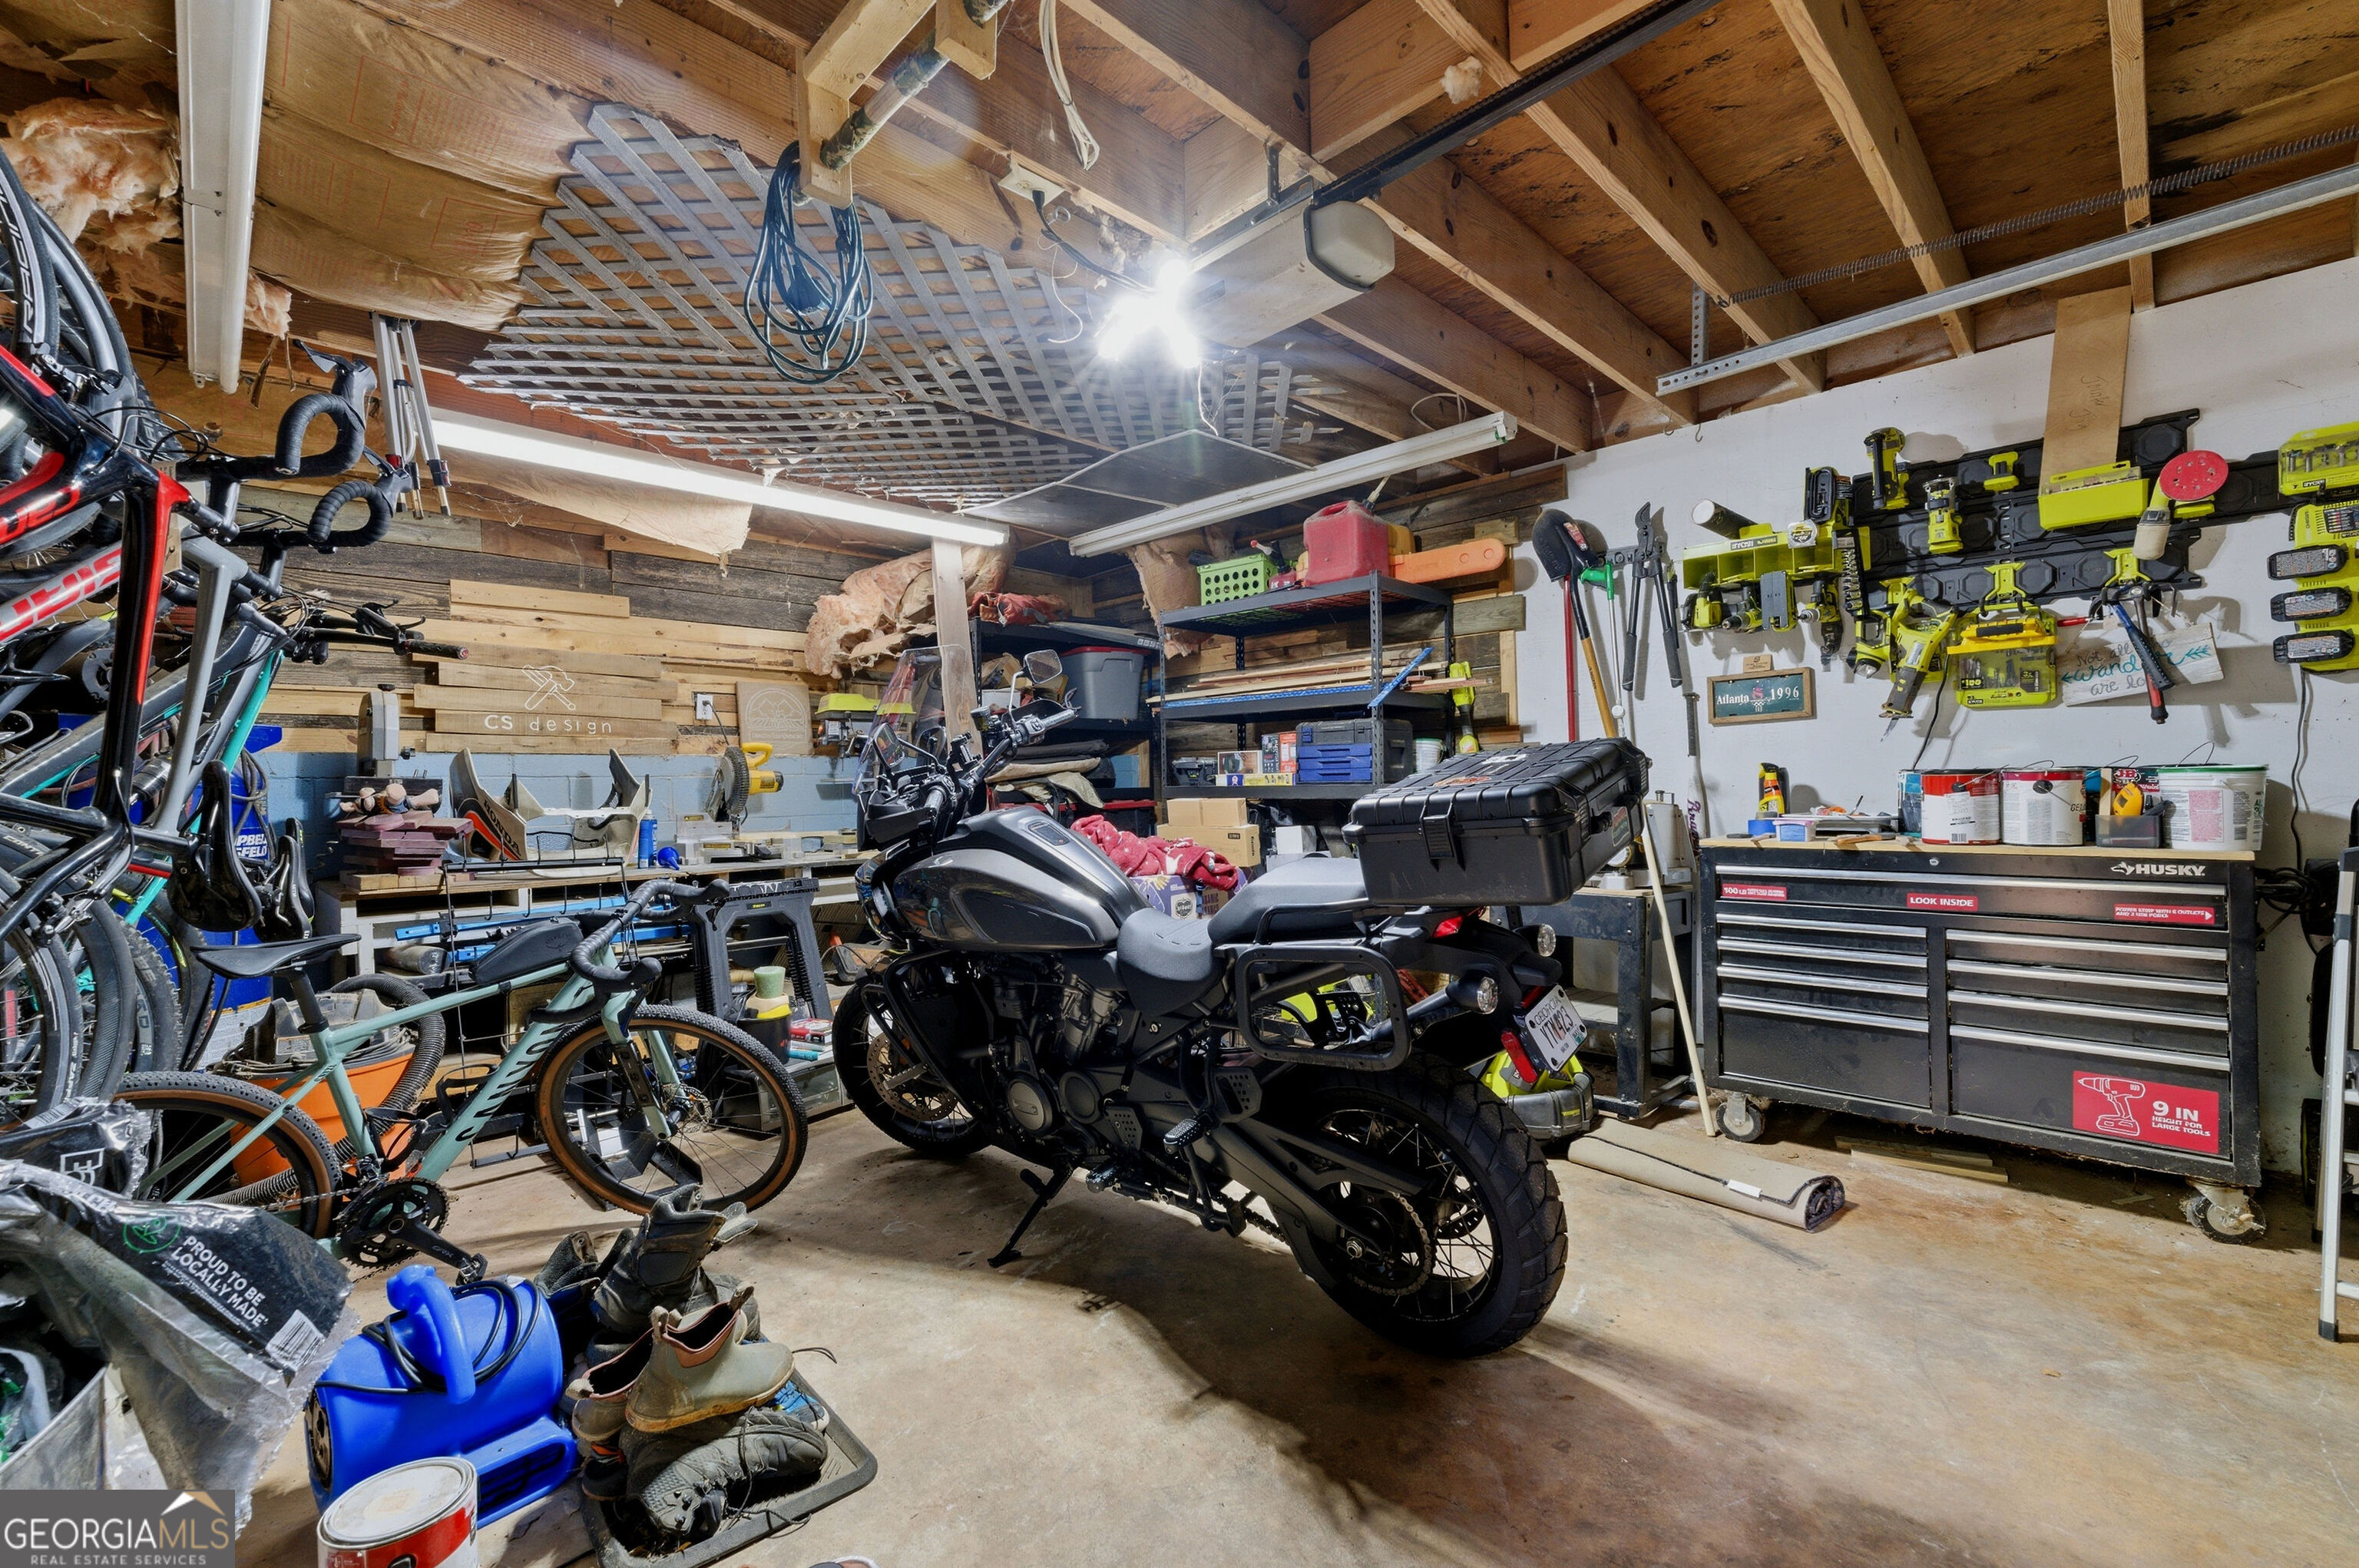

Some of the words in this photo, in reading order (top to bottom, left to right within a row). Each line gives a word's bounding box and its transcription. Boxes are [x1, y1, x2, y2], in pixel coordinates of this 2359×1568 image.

[2076, 650, 2103, 667] Not
[2109, 643, 2132, 659] all
[1716, 693, 1750, 706] Atlanta
[1769, 685, 1800, 700] 1996
[2090, 680, 2119, 696] are
[484, 714, 514, 730] CS
[483, 799, 522, 856] HONDA
[2136, 863, 2205, 876] HUSKY
[1910, 897, 1937, 905] LOOK
[1940, 898, 1974, 907] INSIDE
[1534, 997, 1562, 1026] GEORGIA
[2152, 1100, 2169, 1116] 9
[2175, 1107, 2199, 1122] IN
[2152, 1116, 2182, 1126] HEIGHT
[2185, 1121, 2202, 1130] FOR
[2152, 1121, 2181, 1131] LARGE
[2182, 1126, 2211, 1136] TOOLS
[170, 1246, 232, 1297] LOCALLY
[183, 1235, 229, 1275] PROUD
[227, 1271, 247, 1291] TO
[243, 1286, 266, 1307] BE
